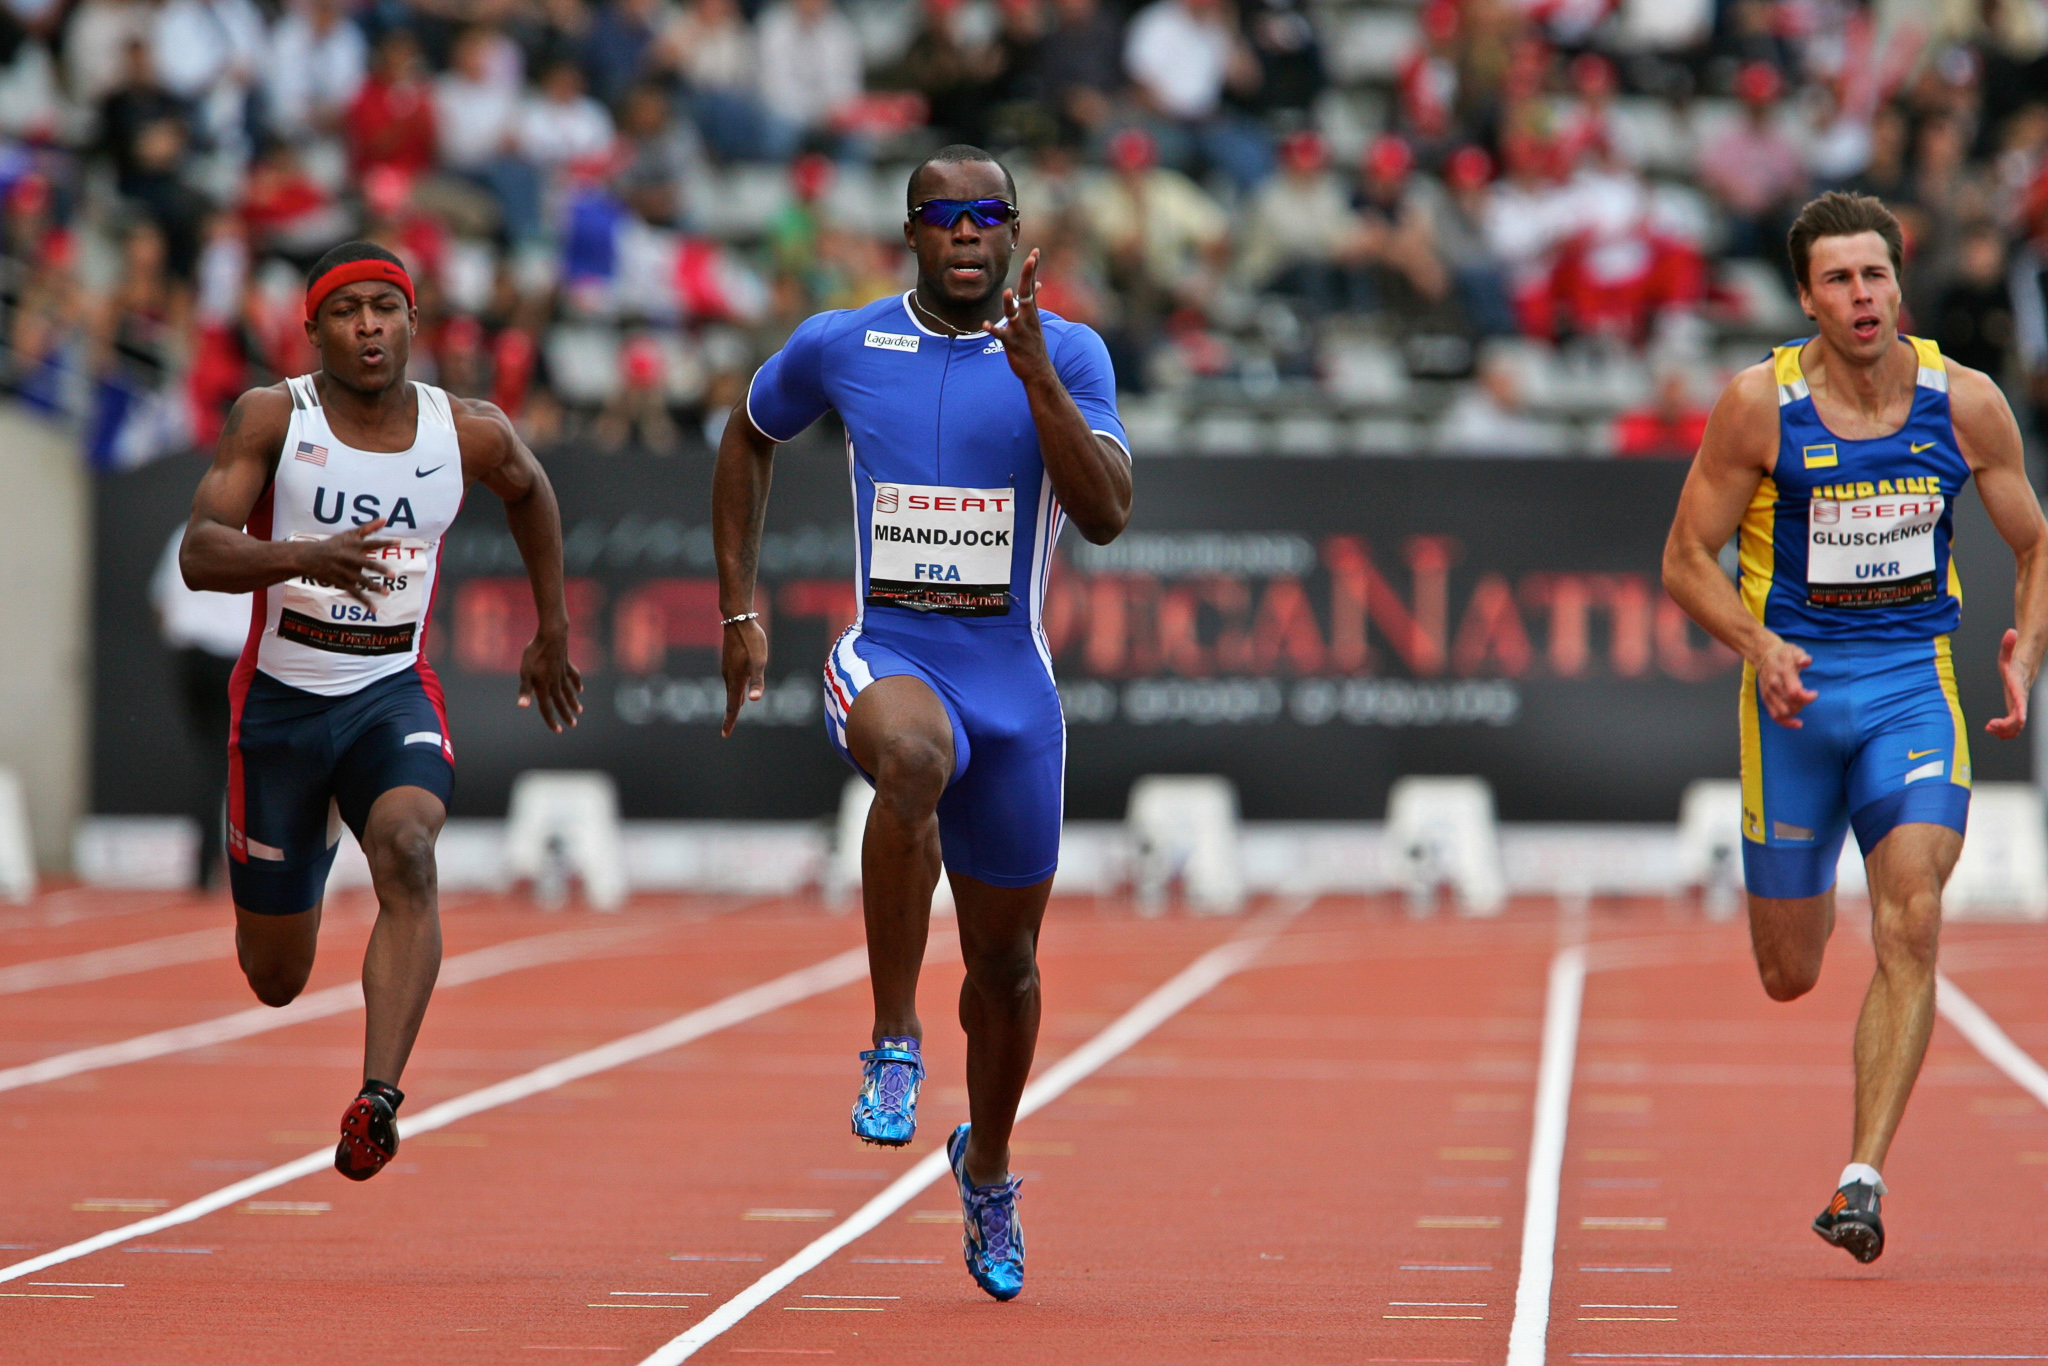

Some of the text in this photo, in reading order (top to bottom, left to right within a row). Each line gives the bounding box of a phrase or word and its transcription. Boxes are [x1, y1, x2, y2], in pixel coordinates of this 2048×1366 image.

[866, 333, 918, 349] Lagardère
[1811, 476, 1941, 501] UKRAINE
[313, 486, 417, 529] USA
[908, 495, 1010, 512] SEAT
[1851, 500, 1941, 519] SEAT
[874, 524, 1010, 546] MBANDJOCK
[1812, 522, 1933, 546] GLUSCHENKO
[914, 563, 961, 581] FRA
[1855, 561, 1900, 579] UKR
[330, 604, 378, 622] USA
